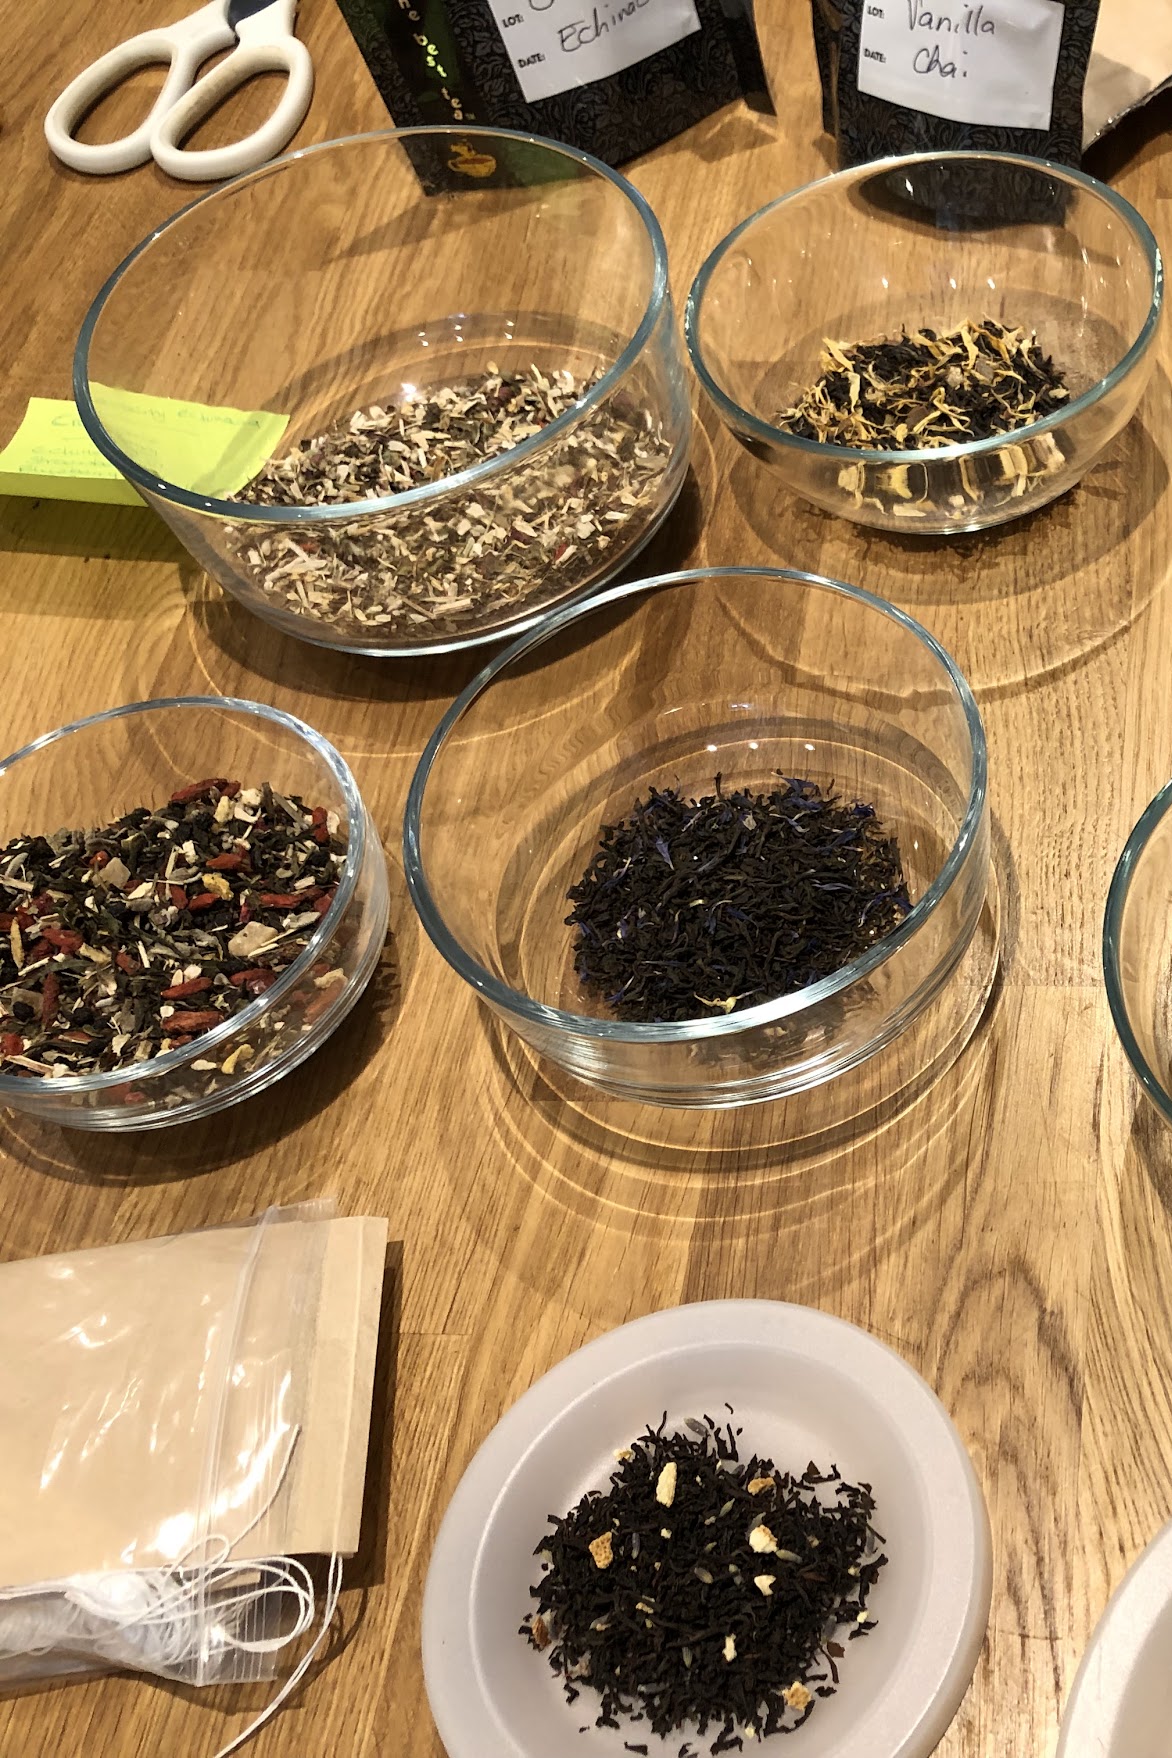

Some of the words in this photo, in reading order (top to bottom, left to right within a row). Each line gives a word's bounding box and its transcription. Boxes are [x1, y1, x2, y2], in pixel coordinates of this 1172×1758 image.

[867, 5, 885, 19] LOT:
[907, 0, 996, 36] Vanilla
[502, 13, 525, 28] LOT:
[518, 53, 546, 68] DATE:
[864, 48, 886, 63] DATE:
[913, 45, 968, 78] Chai
